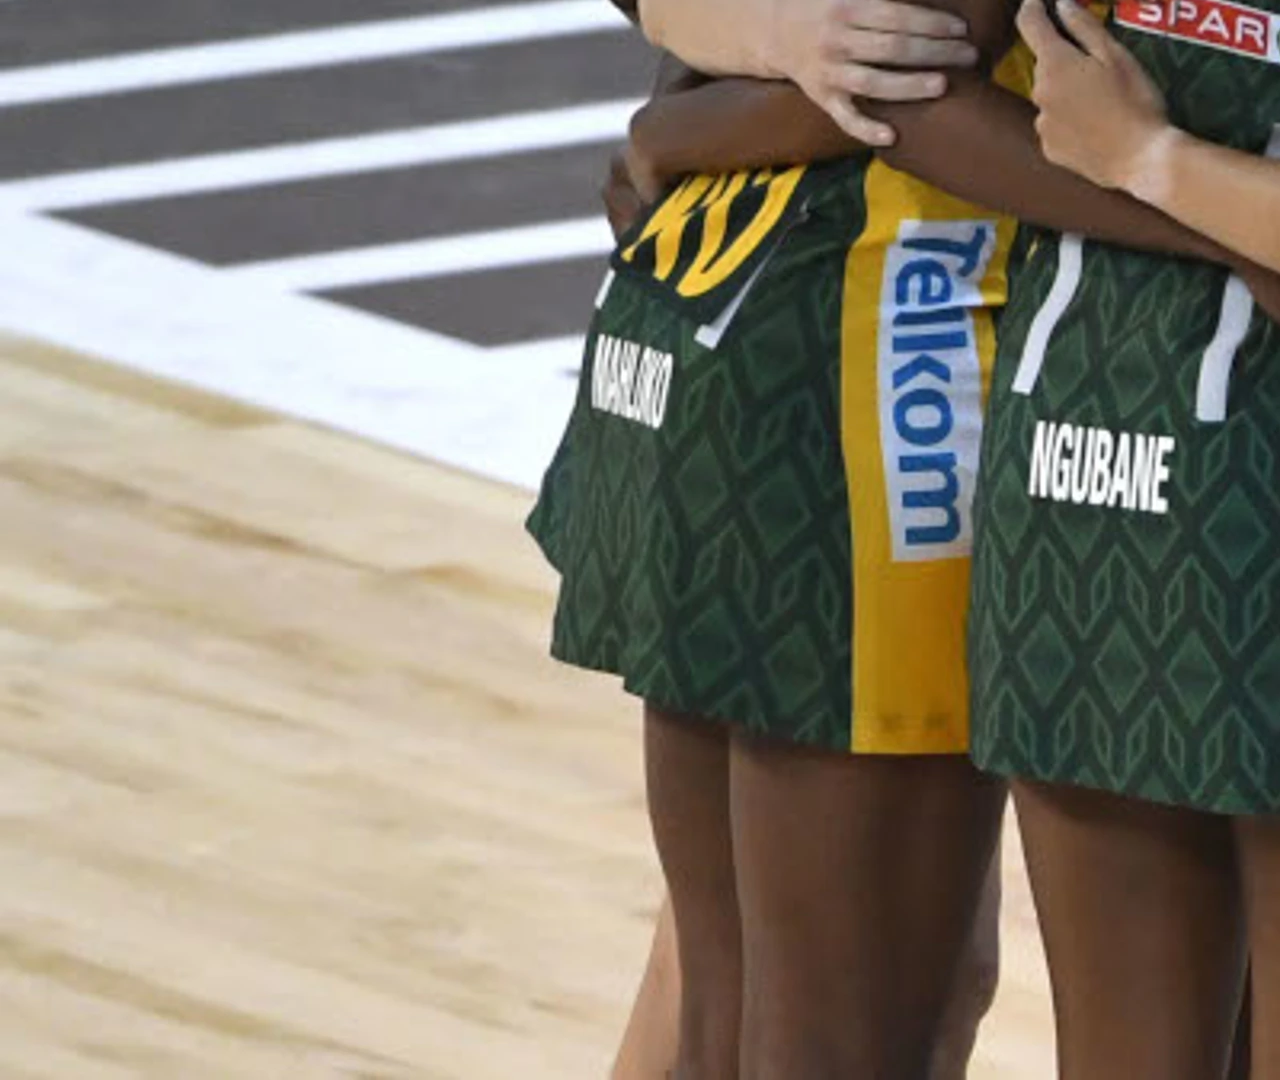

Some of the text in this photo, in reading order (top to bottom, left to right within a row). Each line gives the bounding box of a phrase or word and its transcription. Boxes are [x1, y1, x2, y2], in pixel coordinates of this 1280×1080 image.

[590, 333, 675, 431] MAHLOKO
[891, 225, 988, 546] Telkom
[1028, 420, 1176, 514] NGUBANE
